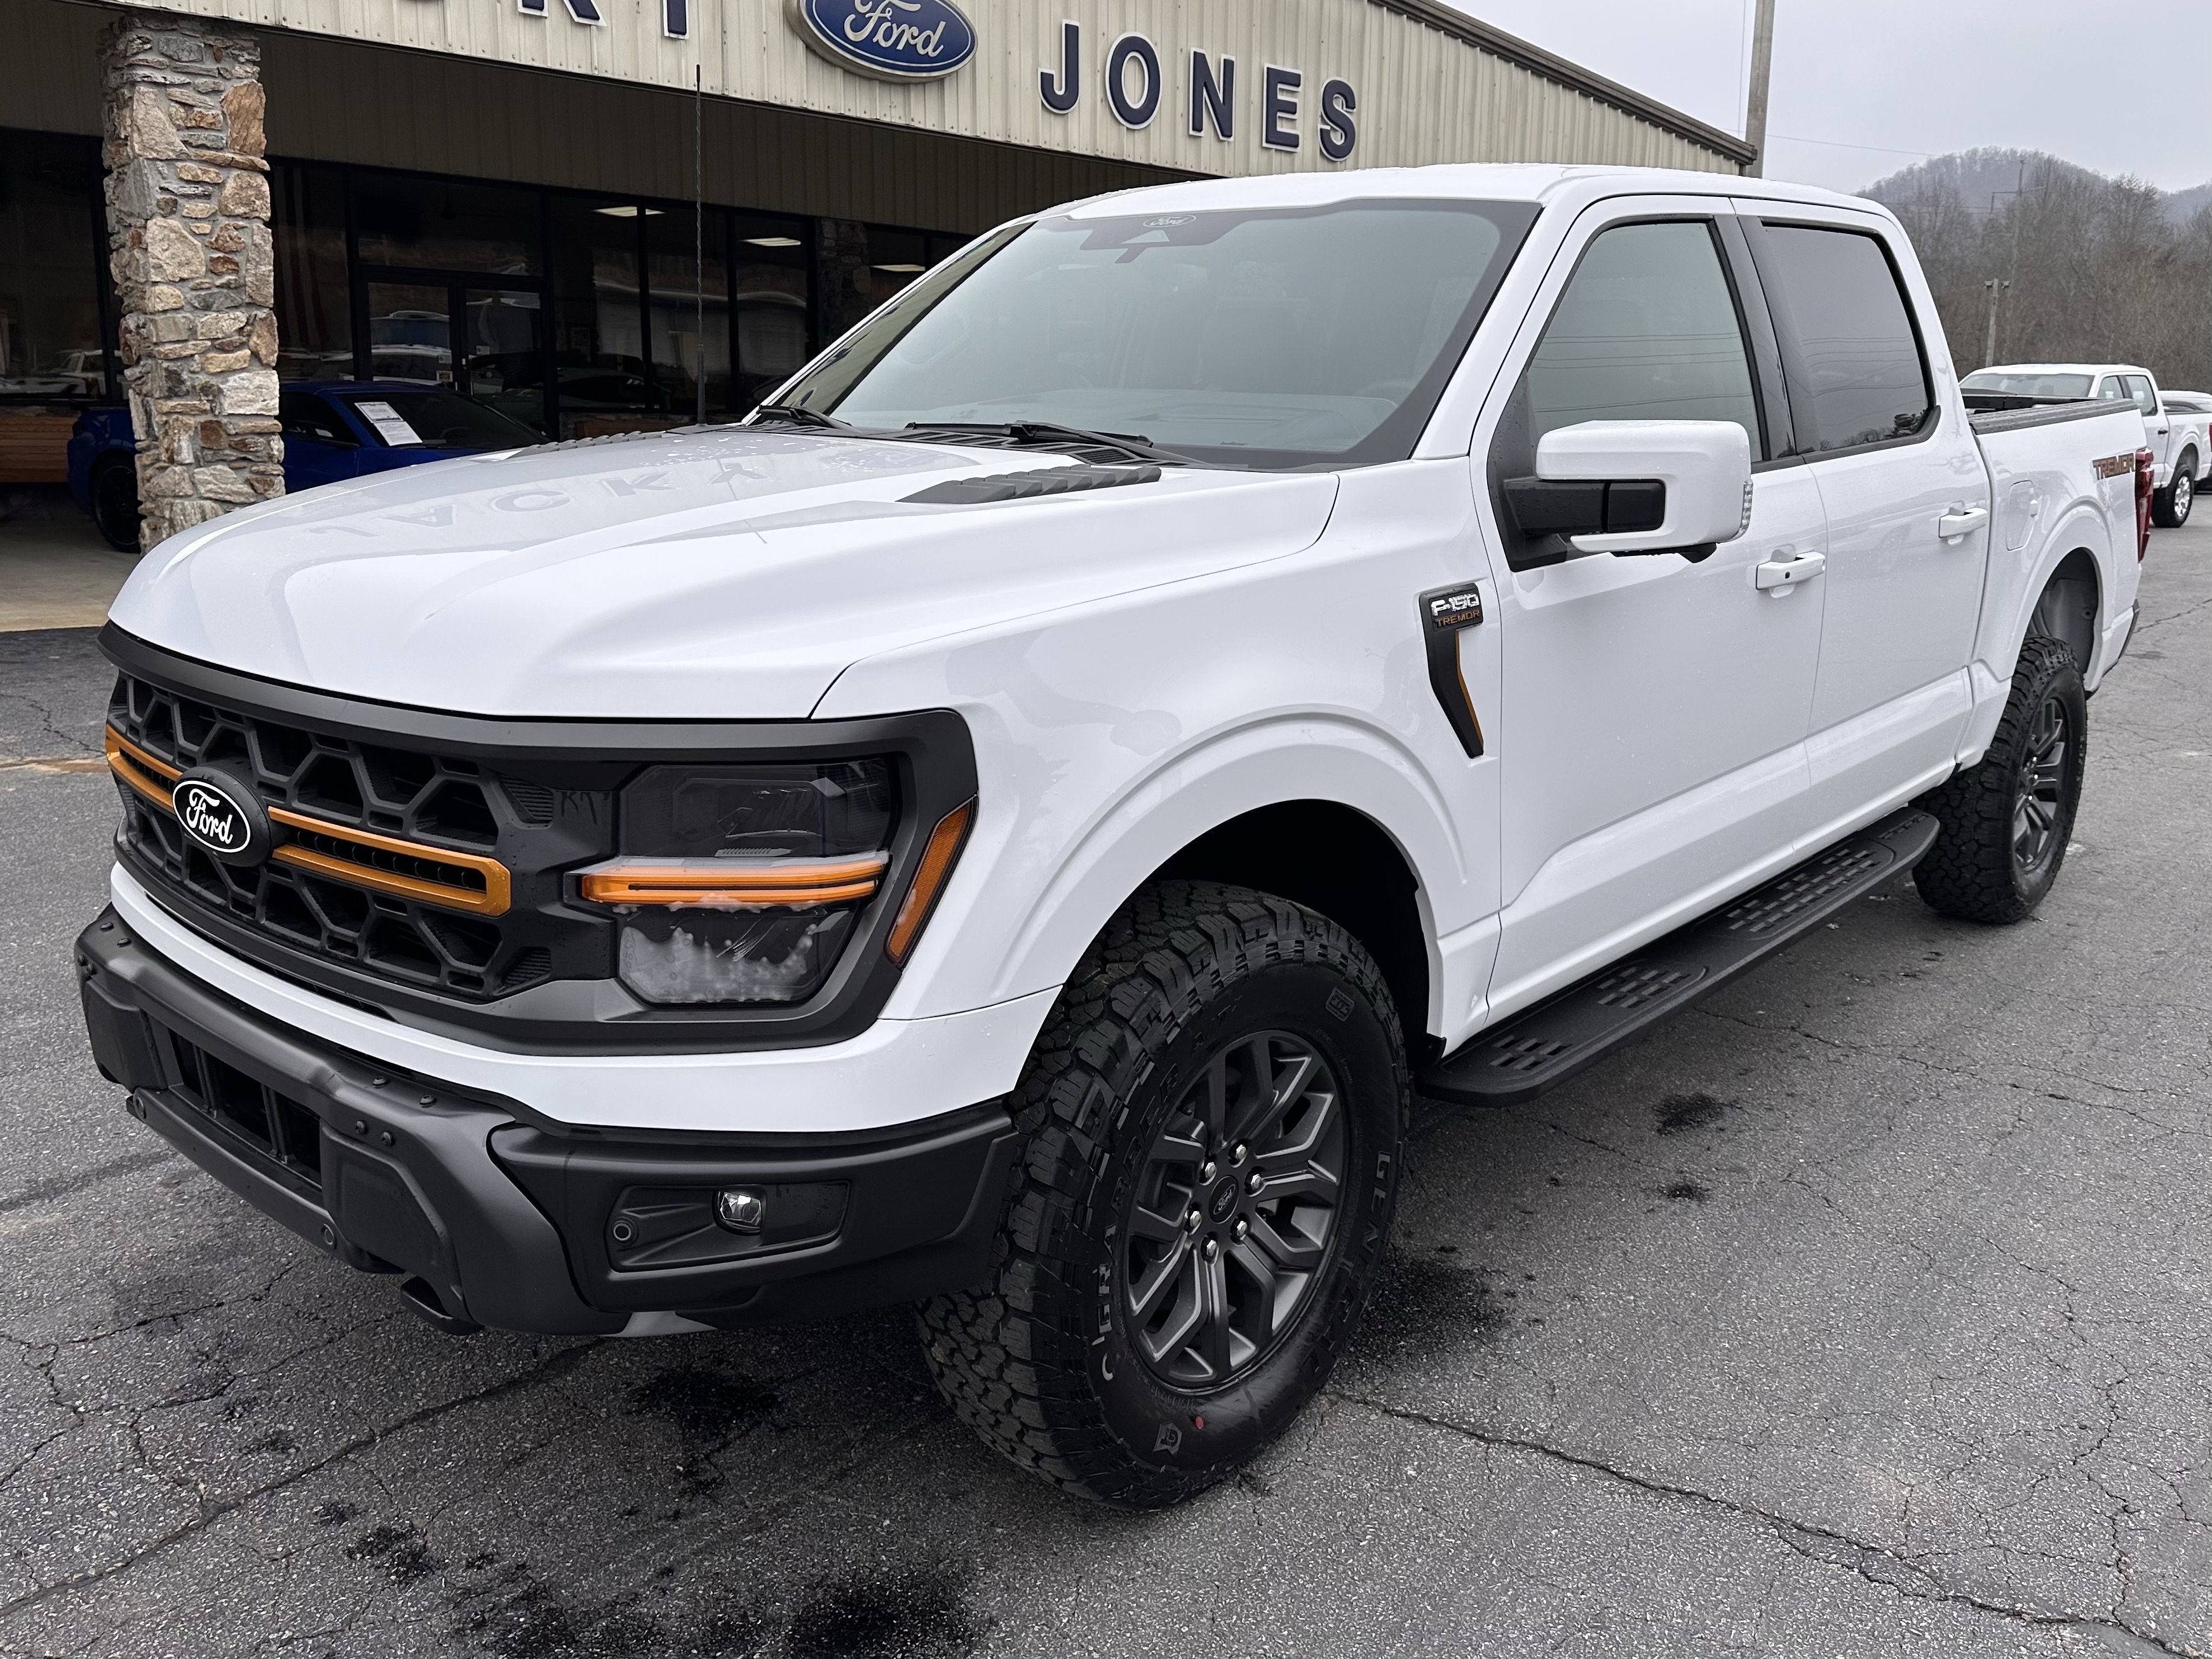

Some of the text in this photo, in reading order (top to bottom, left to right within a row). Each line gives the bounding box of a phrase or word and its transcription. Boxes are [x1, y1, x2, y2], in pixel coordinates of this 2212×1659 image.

[844, 0, 946, 57] Ford
[1038, 20, 1356, 161] JONES
[1150, 216, 1189, 226] Ford
[2091, 452, 2135, 481] TREMOR
[1431, 593, 1480, 616] F-150
[1434, 609, 1480, 628] TREMOR
[186, 788, 233, 844] Ford
[1218, 1188, 1232, 1212] Ford
[1299, 1151, 1391, 1377] GENERAL
